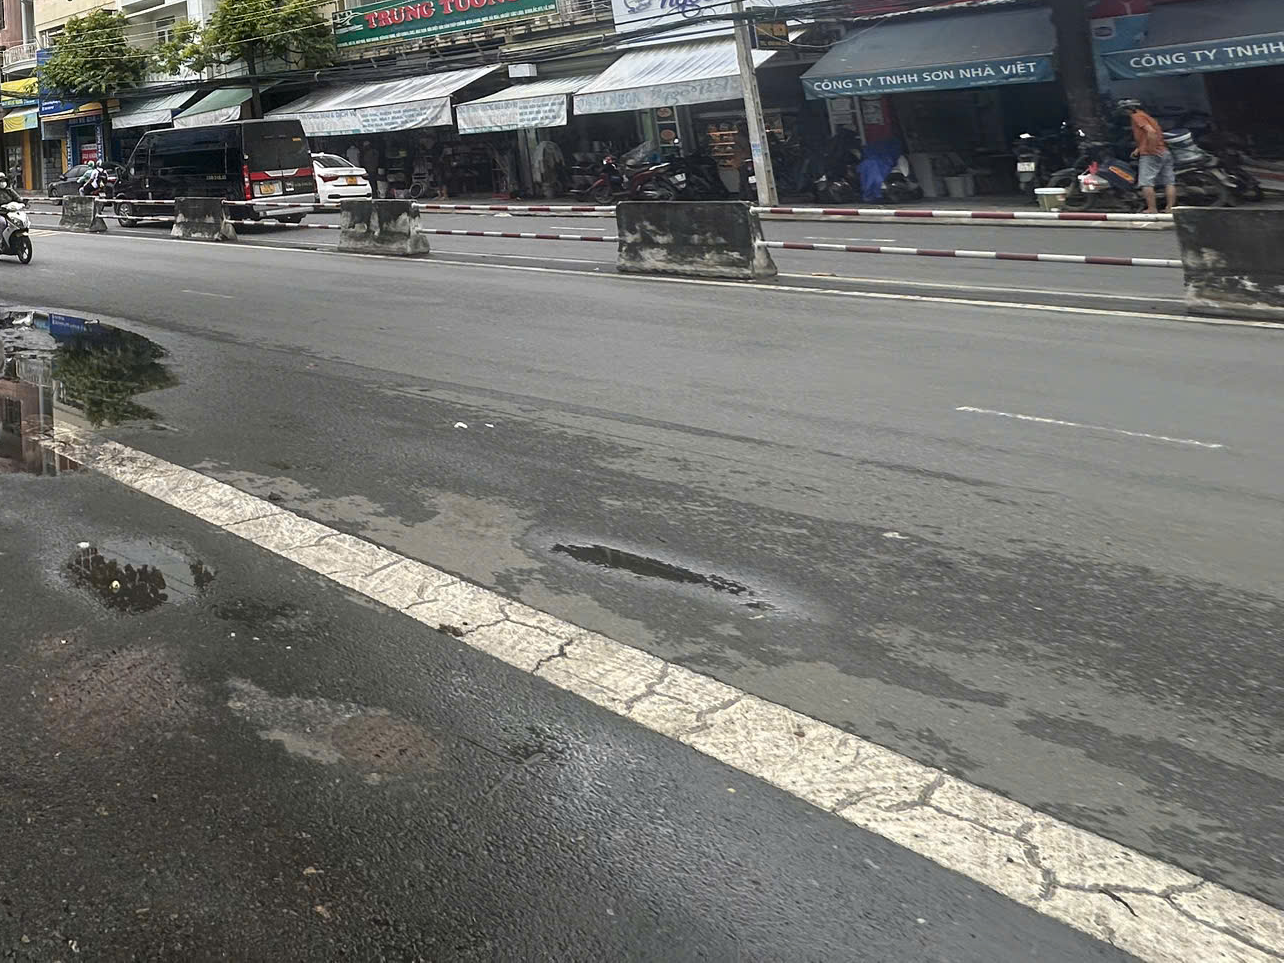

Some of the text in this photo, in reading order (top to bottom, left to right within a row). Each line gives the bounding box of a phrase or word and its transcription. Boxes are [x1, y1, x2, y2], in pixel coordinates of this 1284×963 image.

[364, 1, 435, 29] TRUNG
[1130, 53, 1187, 69] CÔNG
[1191, 48, 1217, 62] TY
[1223, 40, 1284, 58] TNHH
[813, 78, 853, 92] CÔNG
[856, 77, 873, 87] TY
[877, 74, 918, 86] TNHH
[922, 69, 955, 82] SƠN
[959, 63, 996, 79] NHÀ
[1000, 60, 1037, 76] VIỆT
